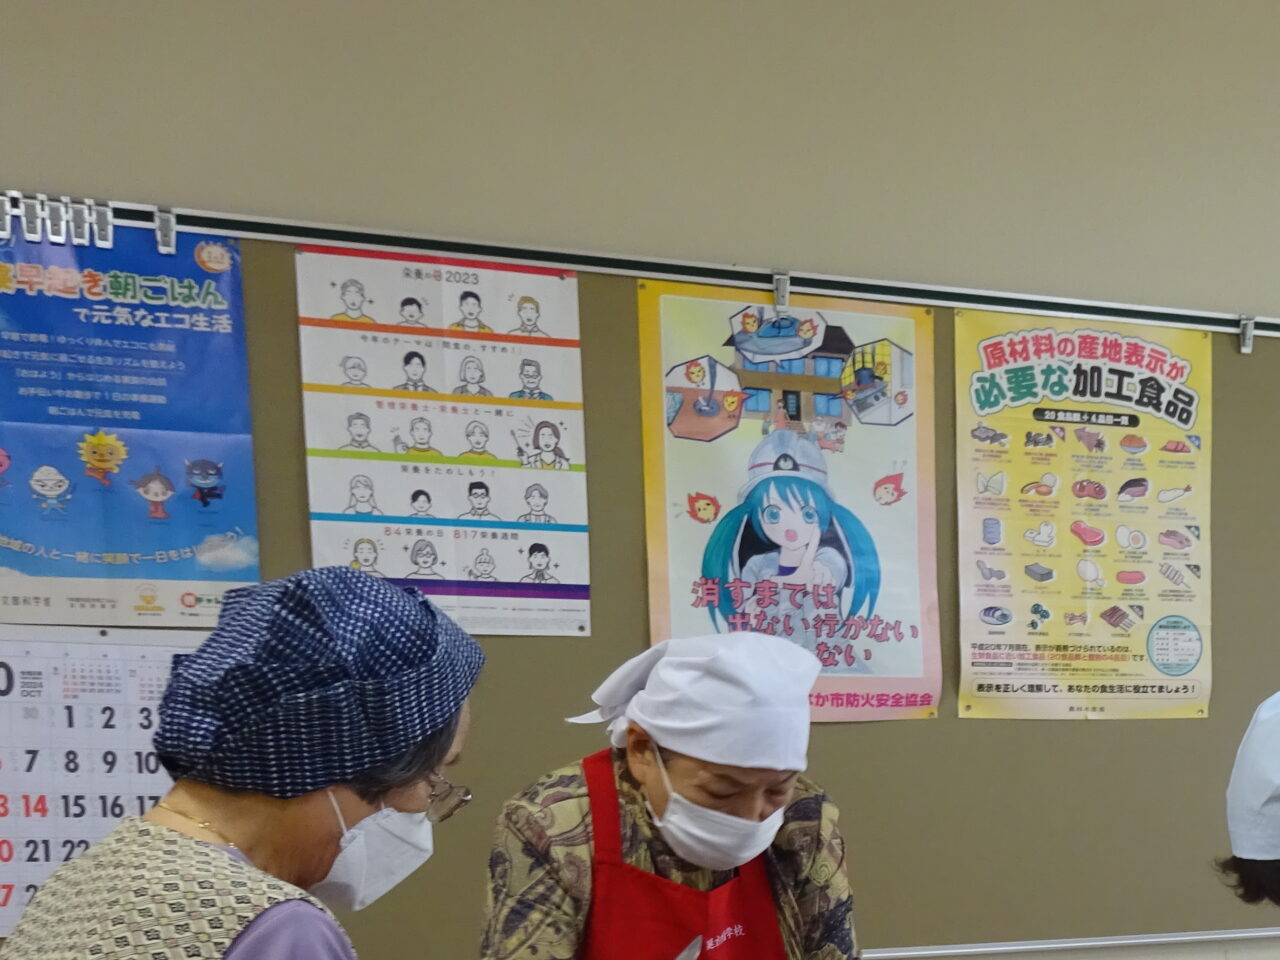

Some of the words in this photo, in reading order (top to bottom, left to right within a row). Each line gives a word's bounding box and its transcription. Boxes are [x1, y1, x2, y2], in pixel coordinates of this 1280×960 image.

[73, 304, 232, 333] で元気なエコ生活
[982, 333, 1188, 381] 原材料の産地表示が
[974, 362, 1196, 426] 必要な加工食品
[691, 576, 838, 609] 消すまでは
[727, 613, 919, 643] 出ない行かない
[20, 690, 42, 698] OCT
[64, 705, 75, 729] 1
[101, 706, 116, 730] 2
[138, 707, 153, 730] 3
[24, 749, 40, 773] 7
[64, 750, 80, 774] 8
[102, 751, 117, 774] 9
[134, 751, 160, 775] 10
[22, 795, 49, 818] 14
[61, 795, 87, 818] 15
[99, 795, 125, 819] 16
[25, 840, 51, 863] 21
